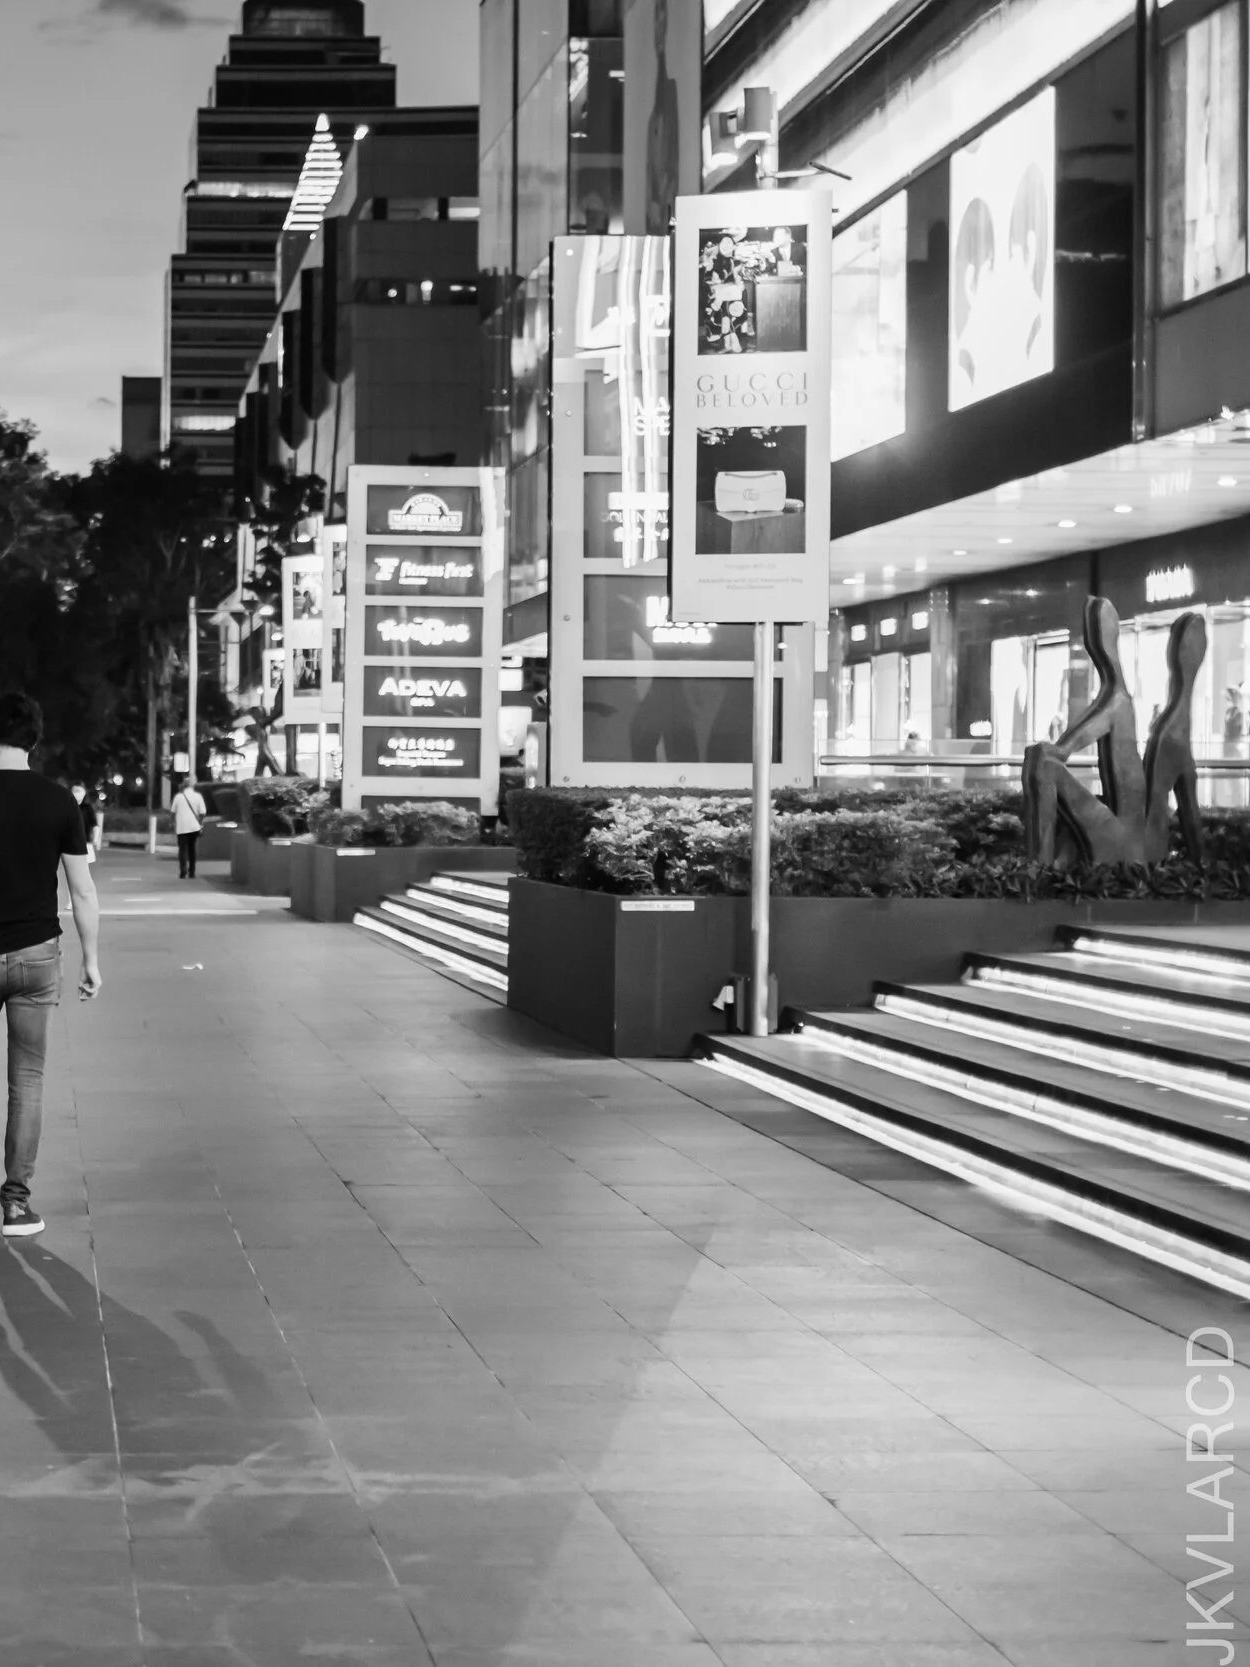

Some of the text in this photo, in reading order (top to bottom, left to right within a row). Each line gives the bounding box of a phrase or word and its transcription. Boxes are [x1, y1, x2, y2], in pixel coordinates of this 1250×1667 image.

[696, 371, 807, 394] GUCCI
[696, 391, 808, 408] BELOVED
[378, 676, 467, 697] ADEVA
